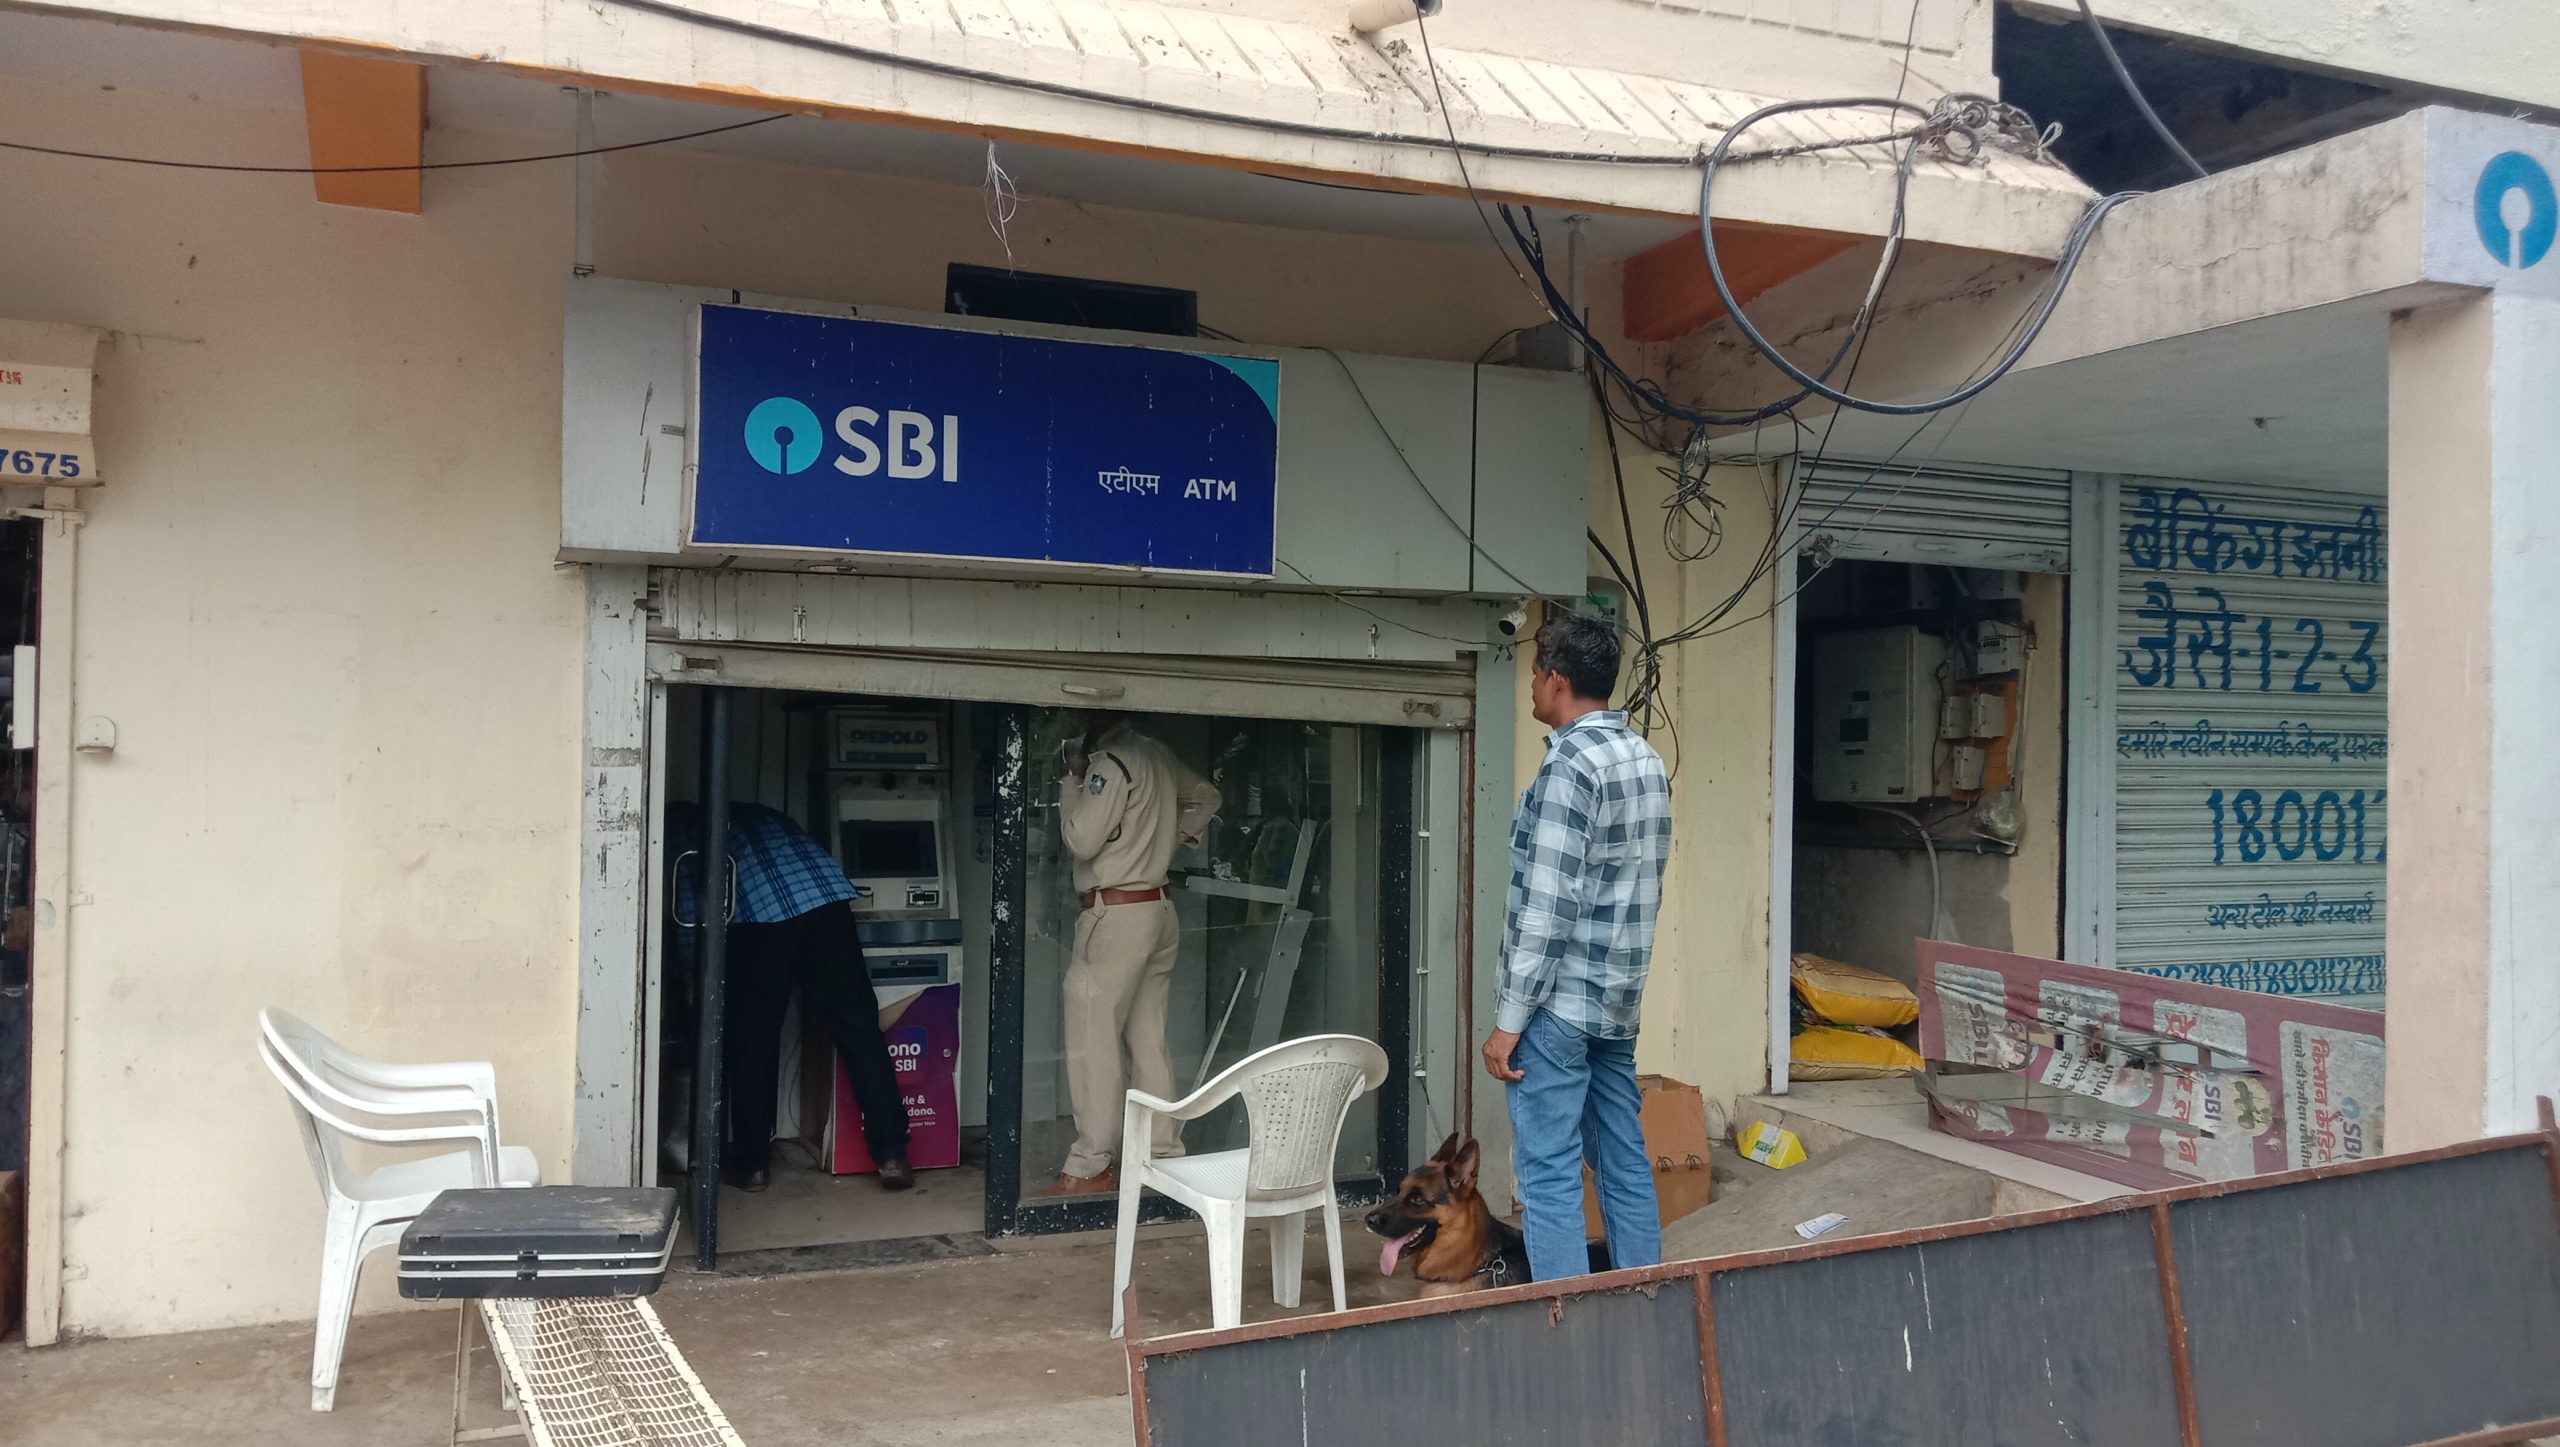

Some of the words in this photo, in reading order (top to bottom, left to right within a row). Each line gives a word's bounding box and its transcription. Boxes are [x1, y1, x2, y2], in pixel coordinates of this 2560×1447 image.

[833, 405, 959, 483] SBI
[1098, 465, 1160, 496] एटीएम
[1183, 478, 1237, 502] ATM
[888, 1043, 921, 1057] ono
[895, 1059, 917, 1072] SBI
[2090, 1064, 2115, 1096] UTUA
[2204, 1084, 2223, 1121] SBI
[2342, 1121, 2363, 1160] SBI
